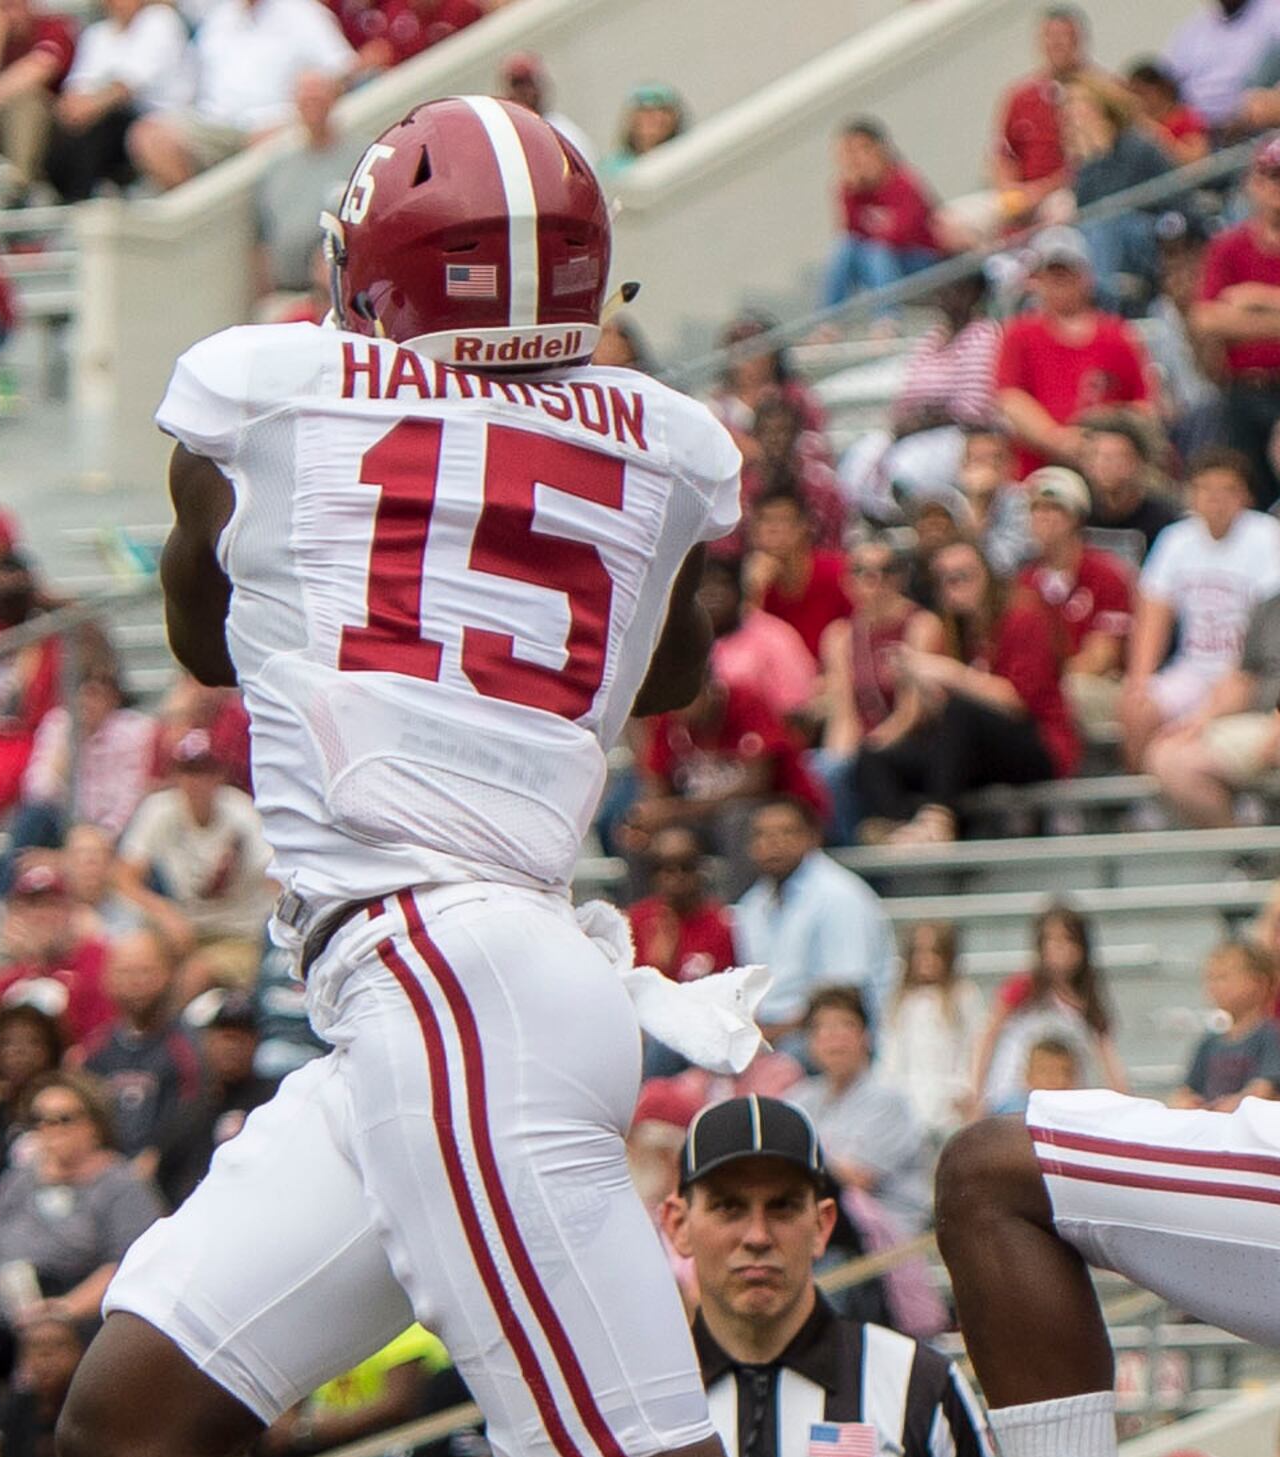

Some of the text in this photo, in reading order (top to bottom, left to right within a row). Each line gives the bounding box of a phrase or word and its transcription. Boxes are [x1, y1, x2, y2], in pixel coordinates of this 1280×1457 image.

[340, 143, 396, 224] 15
[453, 330, 583, 362] Riddell
[338, 414, 627, 721] 15
